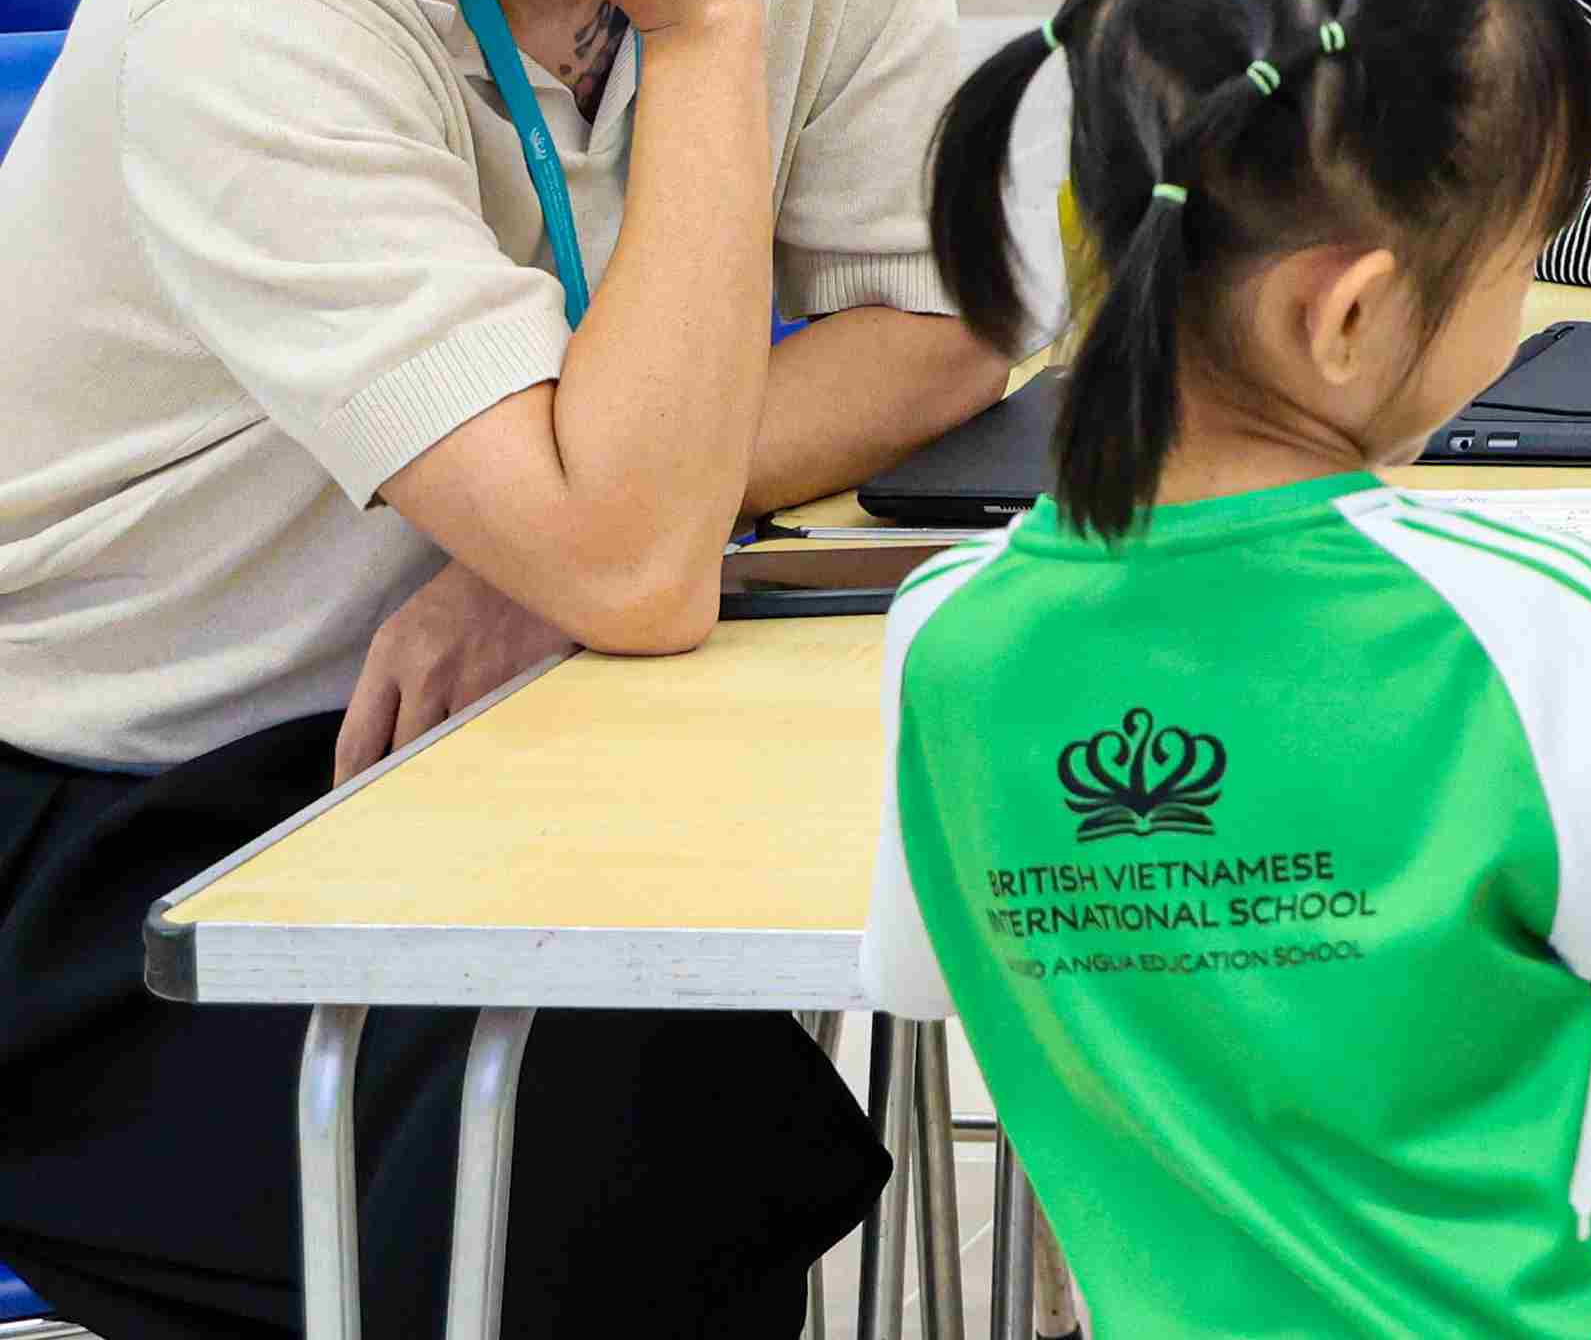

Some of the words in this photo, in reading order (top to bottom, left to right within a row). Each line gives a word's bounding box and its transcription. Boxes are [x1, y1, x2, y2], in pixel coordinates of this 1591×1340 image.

[986, 863, 1098, 898] BRITISH
[1104, 851, 1335, 892] VIETNAMESE
[1228, 889, 1377, 928] SCHOOL
[1273, 939, 1366, 967] SCHOOL
